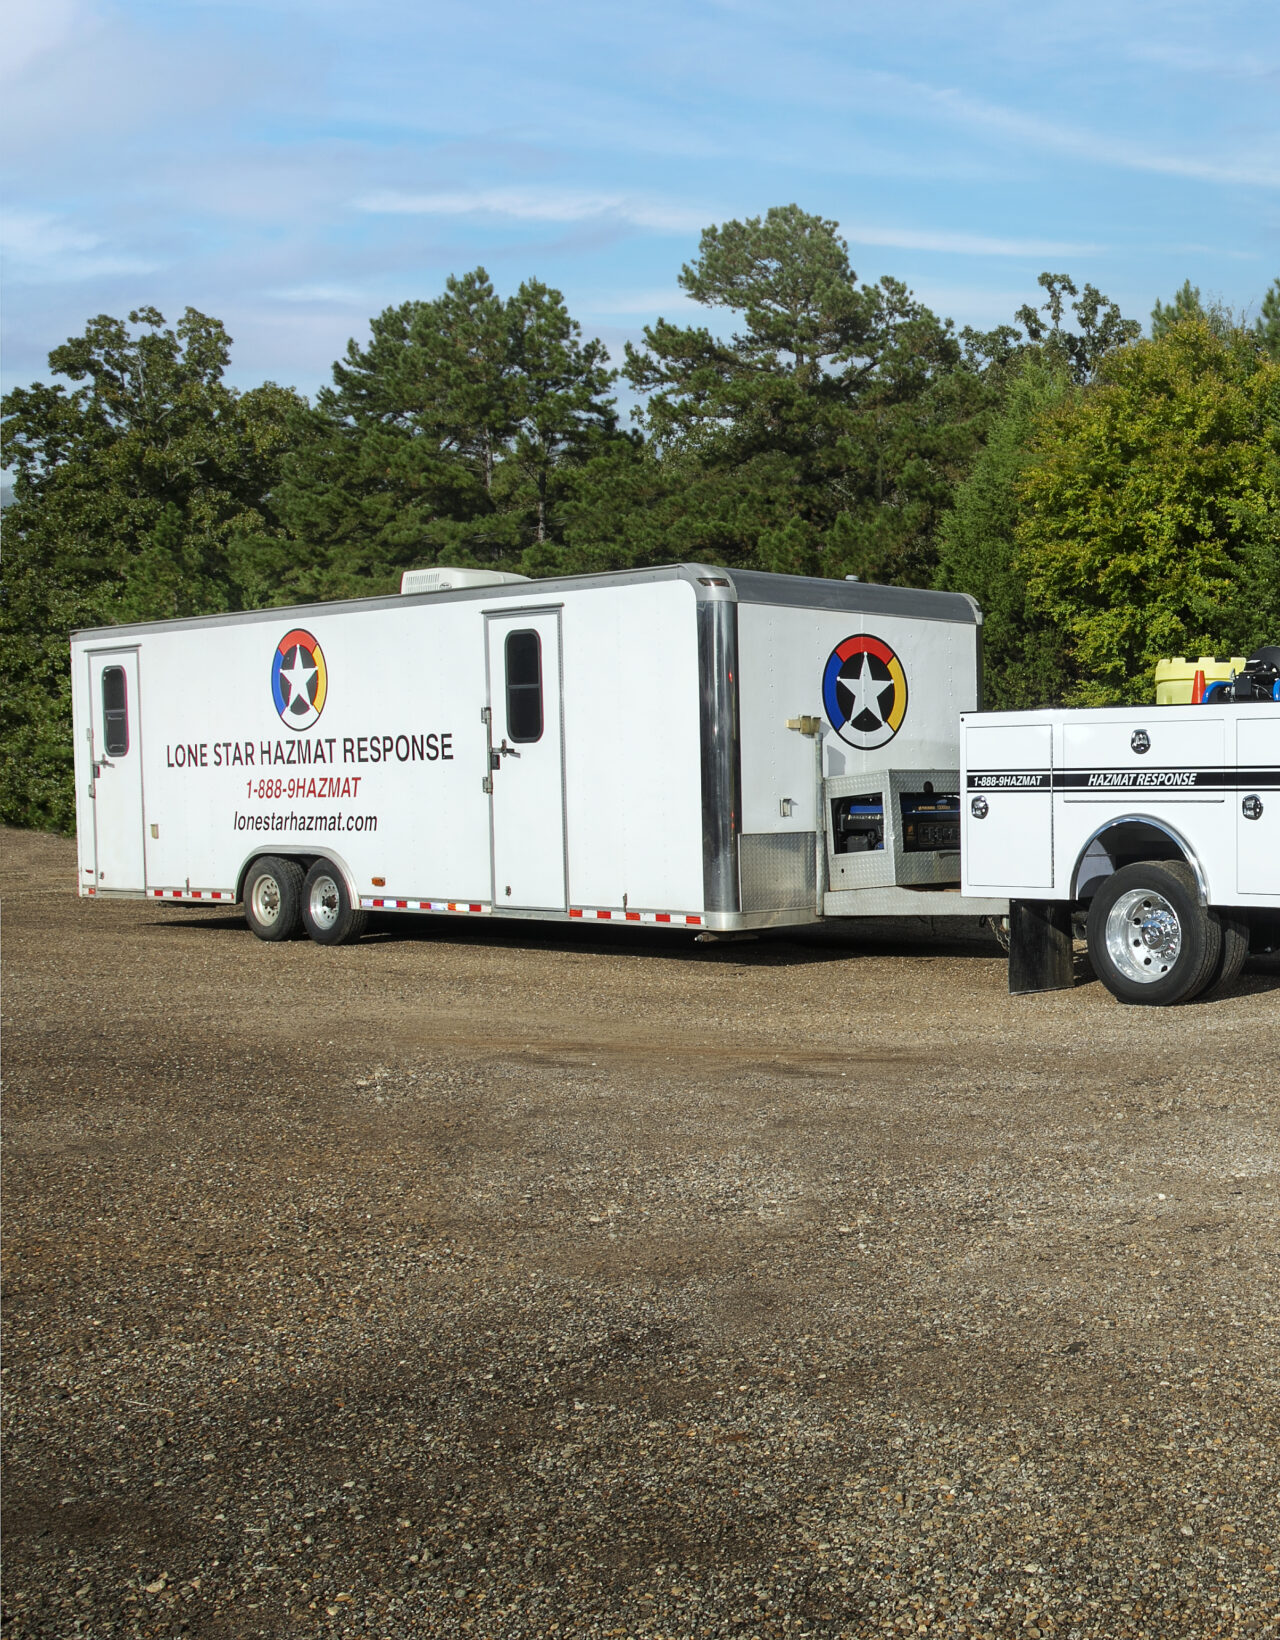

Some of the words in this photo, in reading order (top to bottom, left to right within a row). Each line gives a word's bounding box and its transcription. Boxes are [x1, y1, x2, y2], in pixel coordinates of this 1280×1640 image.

[167, 743, 208, 768] LONE
[213, 741, 255, 767] STAR
[260, 738, 337, 766] HAZMAT
[343, 733, 454, 763] RESPONSE
[246, 777, 362, 799] 1-888-9HAZMAT
[973, 775, 1043, 787] 1-888-9HAZMAT
[1087, 773, 1136, 786] HAZMAT
[1136, 772, 1198, 786] RESPONSE
[233, 811, 378, 831] lonestarhazmat.com
